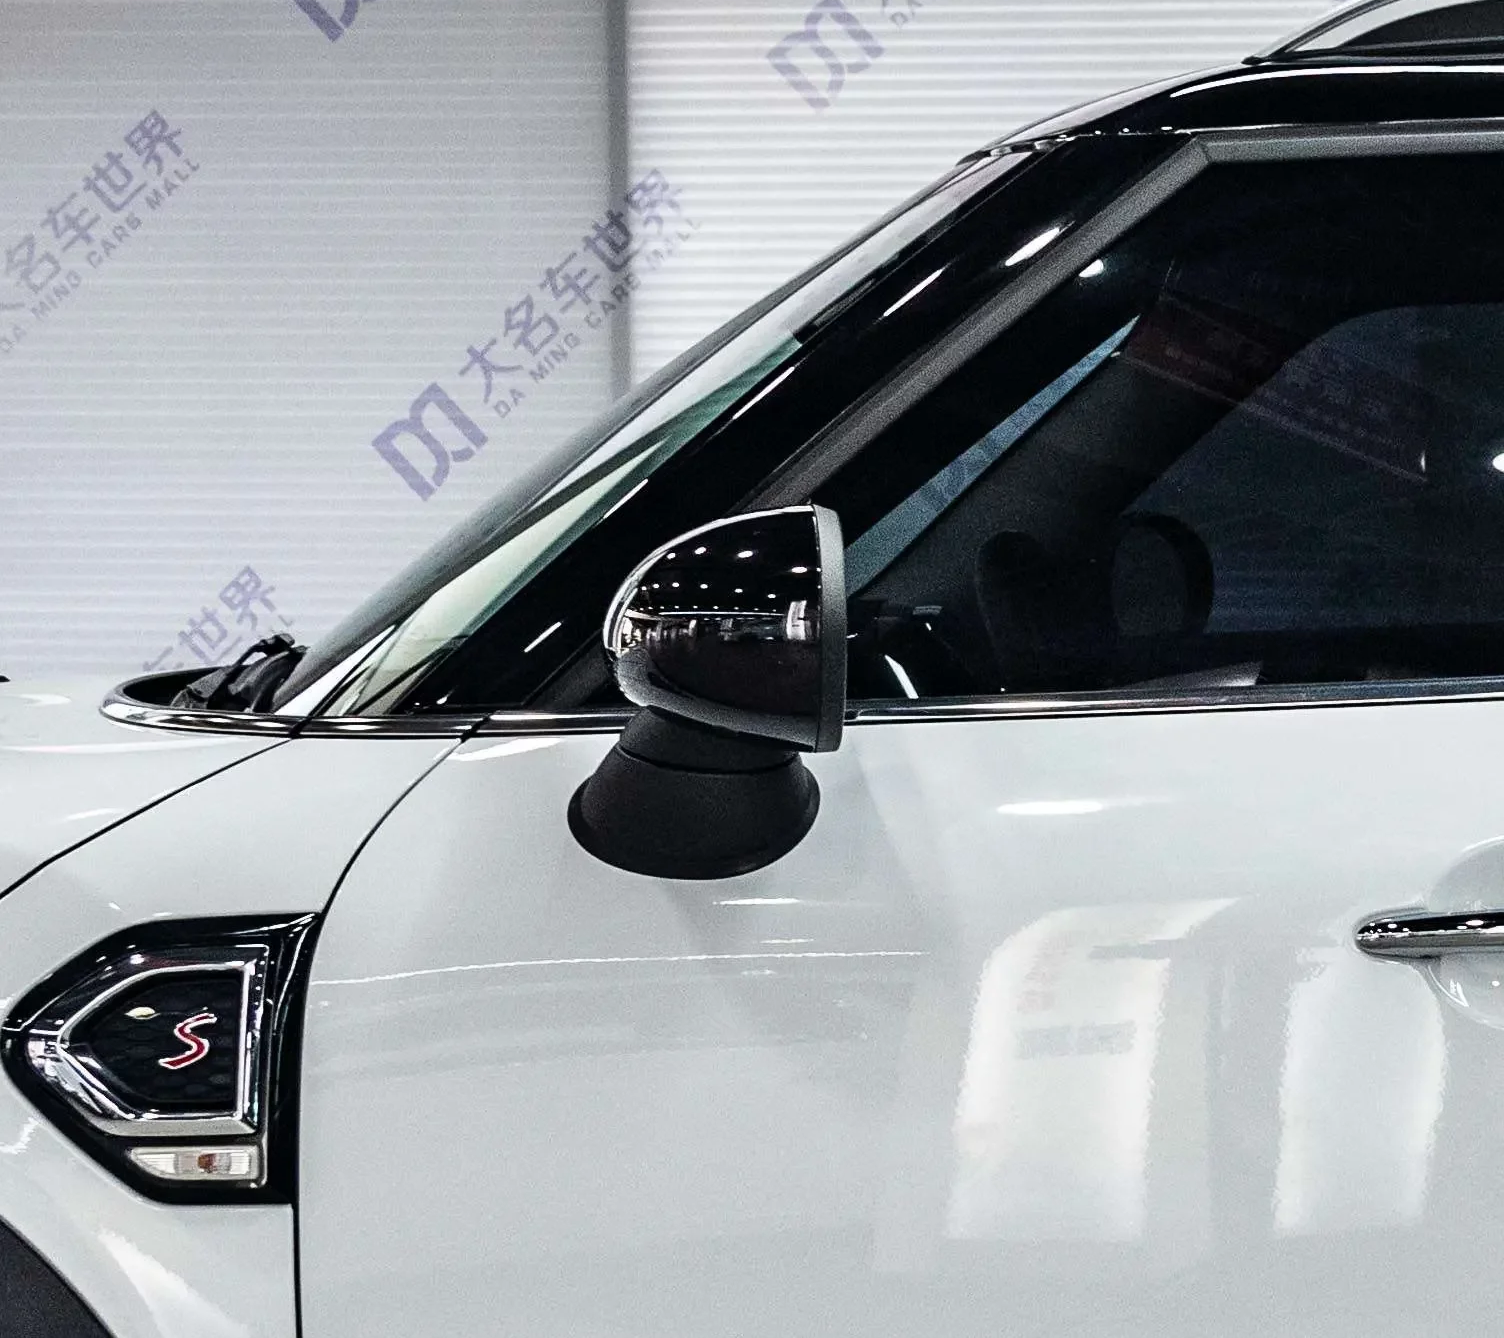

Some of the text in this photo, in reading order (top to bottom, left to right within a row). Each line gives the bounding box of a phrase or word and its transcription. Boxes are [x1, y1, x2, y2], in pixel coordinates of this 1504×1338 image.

[142, 160, 200, 211] MALL
[462, 172, 687, 401] 大名车世界
[158, 1012, 217, 1069] S
